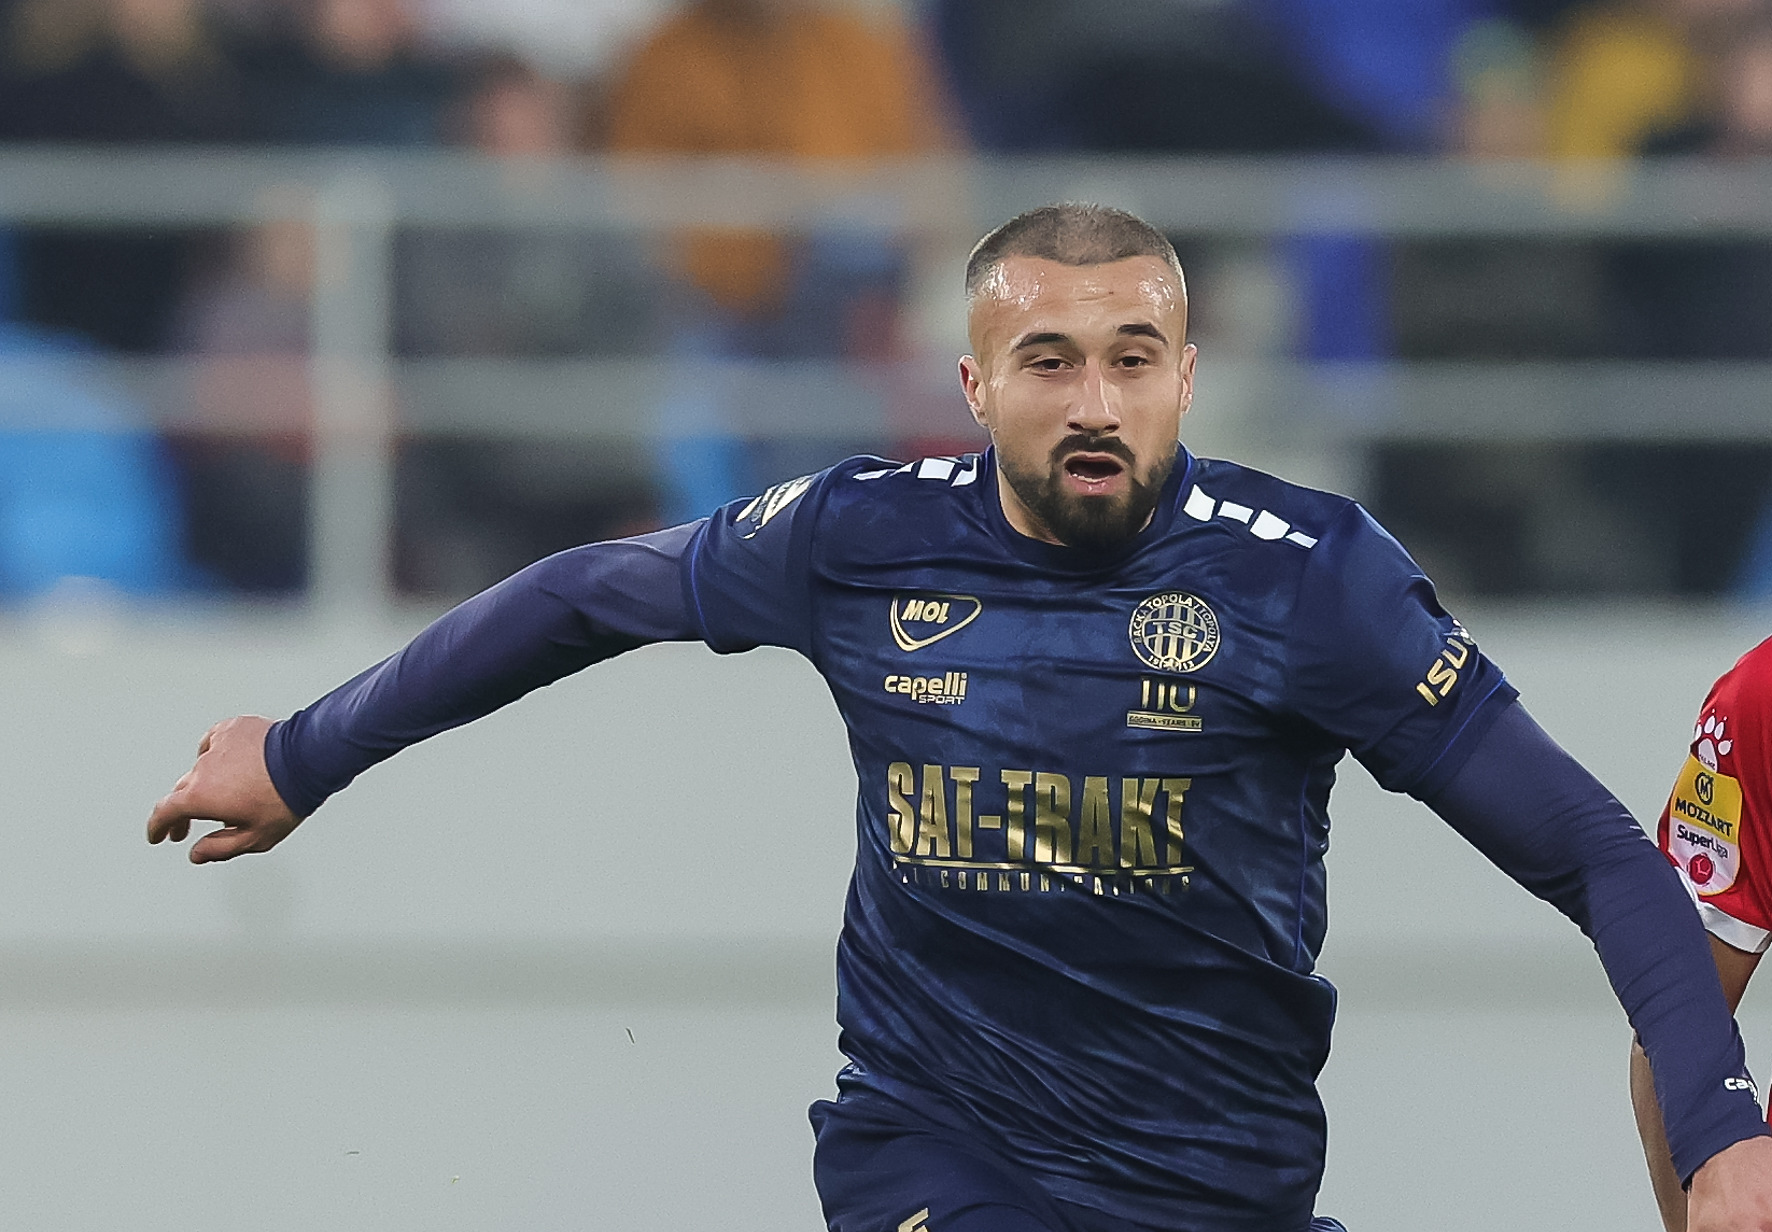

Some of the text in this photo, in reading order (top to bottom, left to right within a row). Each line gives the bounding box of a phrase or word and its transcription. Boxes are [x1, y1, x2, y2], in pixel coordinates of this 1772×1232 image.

[901, 599, 950, 624] MOL
[1152, 621, 1198, 639] TSC
[884, 671, 967, 701] capelli
[918, 694, 965, 705] SPORT
[887, 761, 1192, 869] SAT-TRAKT
[1675, 797, 1733, 837] MOZZART
